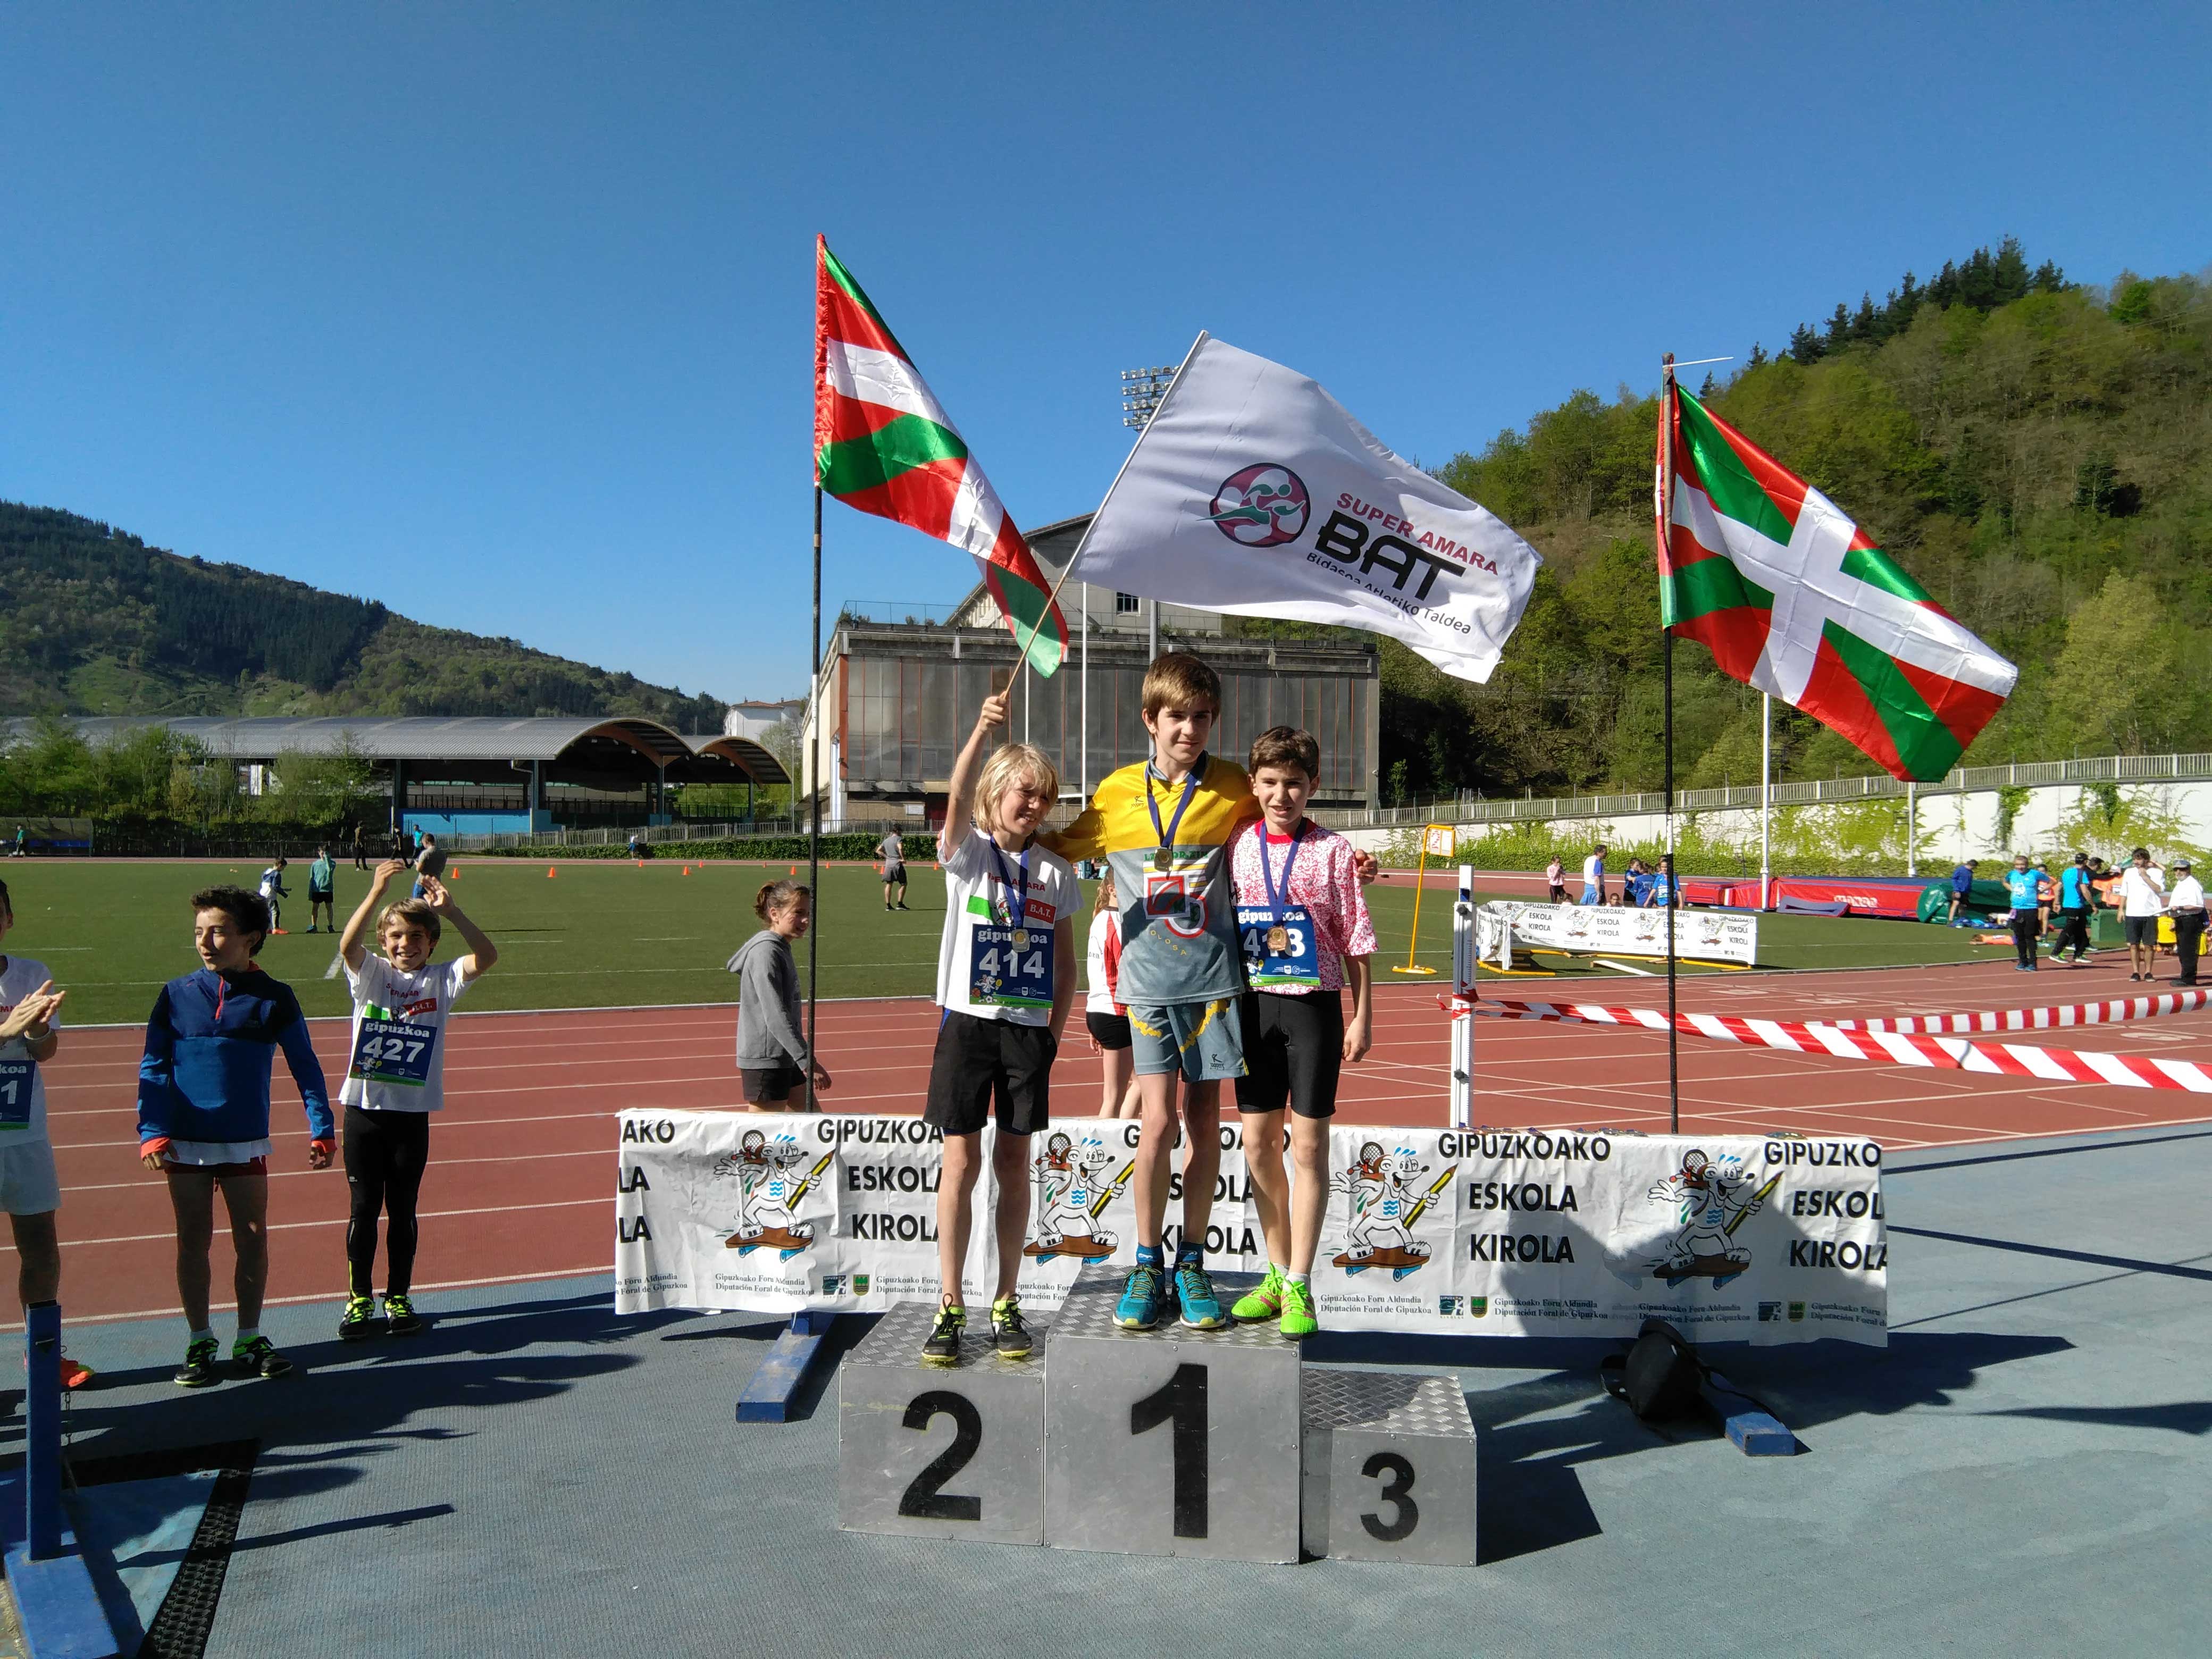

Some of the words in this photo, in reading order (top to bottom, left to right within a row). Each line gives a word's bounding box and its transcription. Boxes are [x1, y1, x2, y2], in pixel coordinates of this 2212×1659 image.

[1336, 492, 1415, 539] SUPER
[1417, 531, 1498, 576] AMARA
[1314, 509, 1467, 601] BAT
[1424, 607, 1471, 635] Taldea
[1523, 902, 1560, 910] GIPUZKOAKO
[1238, 909, 1305, 924] gipuzoa
[977, 928, 1048, 944] gipuoa
[978, 948, 1045, 978] 414
[364, 1021, 430, 1038] gipuzkoa
[362, 1036, 425, 1063] 427
[1438, 1133, 1611, 1161] GIPUZKOAKO
[1469, 1182, 1578, 1212] ESKOLA
[1470, 1234, 1575, 1263] KIROLA
[644, 1273, 678, 1283] Aldundia
[715, 1273, 756, 1283] Gipuzkoako
[776, 1276, 805, 1285] Aldundia
[876, 1276, 919, 1285] Gipuzkoako
[621, 1287, 641, 1295] Foral
[653, 1282, 688, 1292] Gipuzkoa
[716, 1283, 752, 1292] Diputación
[783, 1287, 815, 1297] Gipuzkoa
[876, 1286, 916, 1295] Diputación
[1320, 1294, 1365, 1303] Gipuzkoako
[1495, 1297, 1540, 1306] Gipuzkoako
[1542, 1299, 1561, 1308] Foru
[1320, 1304, 1361, 1313] Diputación
[1395, 1305, 1431, 1315] Gipuzkoa
[1495, 1308, 1536, 1317] Diputación
[1570, 1310, 1608, 1320] Gipuzkoa
[1638, 1303, 1687, 1313] Gipuzkoako
[1811, 1302, 1858, 1312] Gipuzkoako
[1811, 1311, 1854, 1321] Diputación
[898, 1389, 983, 1522] 2
[1130, 1362, 1209, 1539] 1
[1360, 1452, 1420, 1541] 3
